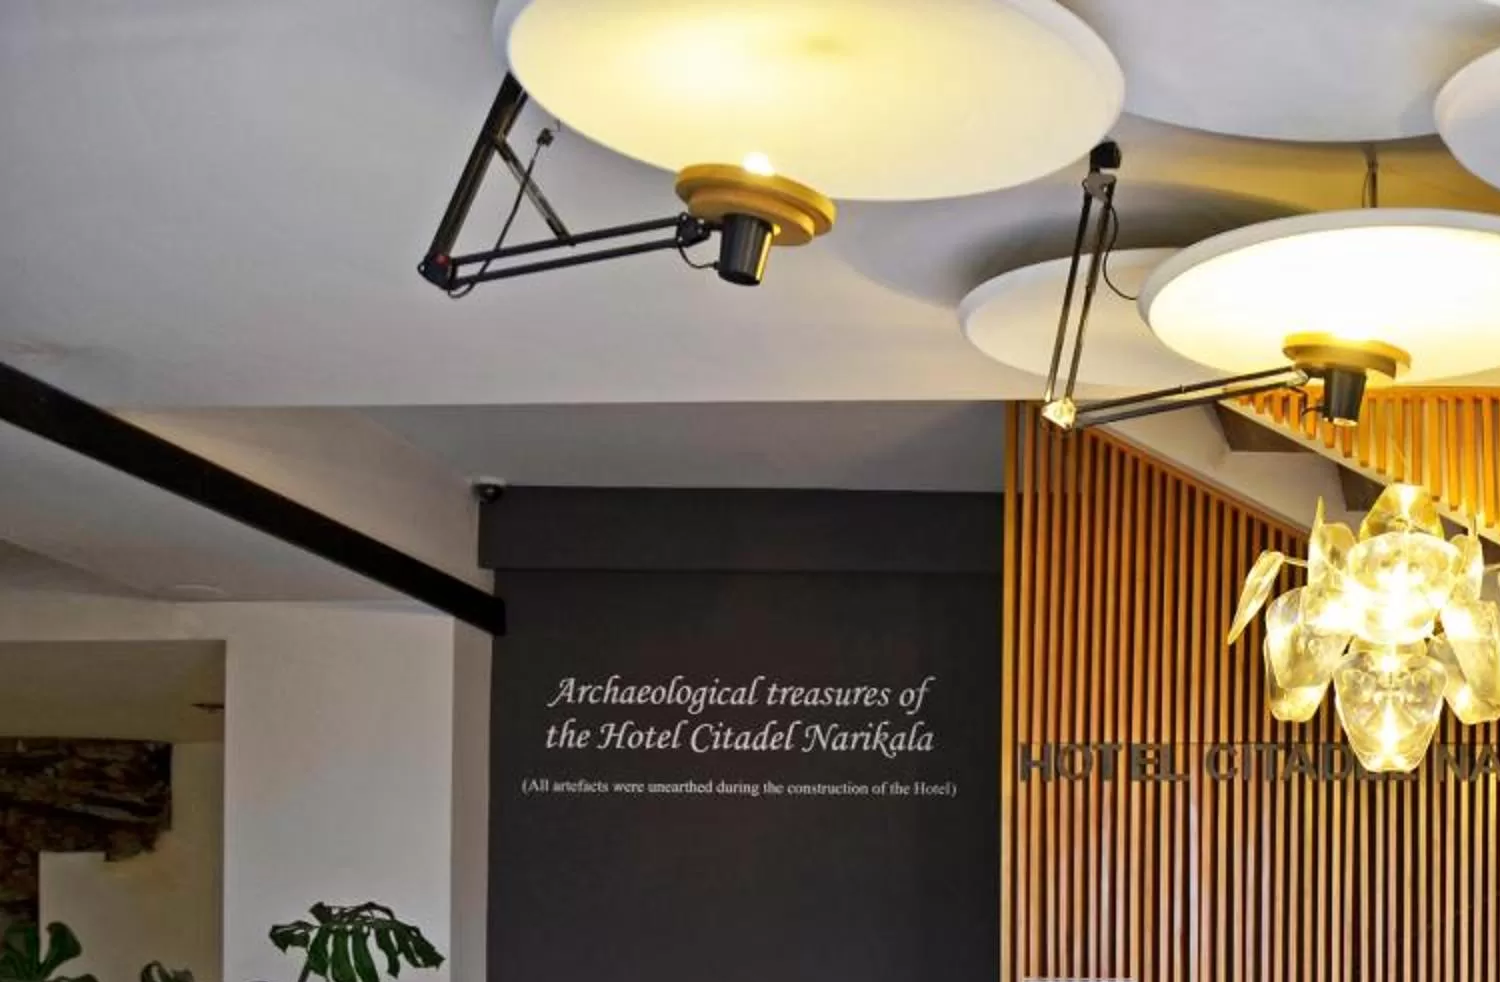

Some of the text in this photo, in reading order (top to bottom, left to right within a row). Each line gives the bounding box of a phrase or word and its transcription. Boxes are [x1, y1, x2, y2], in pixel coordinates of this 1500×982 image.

[546, 674, 936, 715] Archaeological treasures of
[545, 717, 935, 759] the Hotel Citadel Narikala
[1019, 742, 1190, 782] HOTEL
[1205, 742, 1418, 782] CITAD
[521, 778, 957, 798] (All artefacts were unearthed during the construction of the Hotel)
